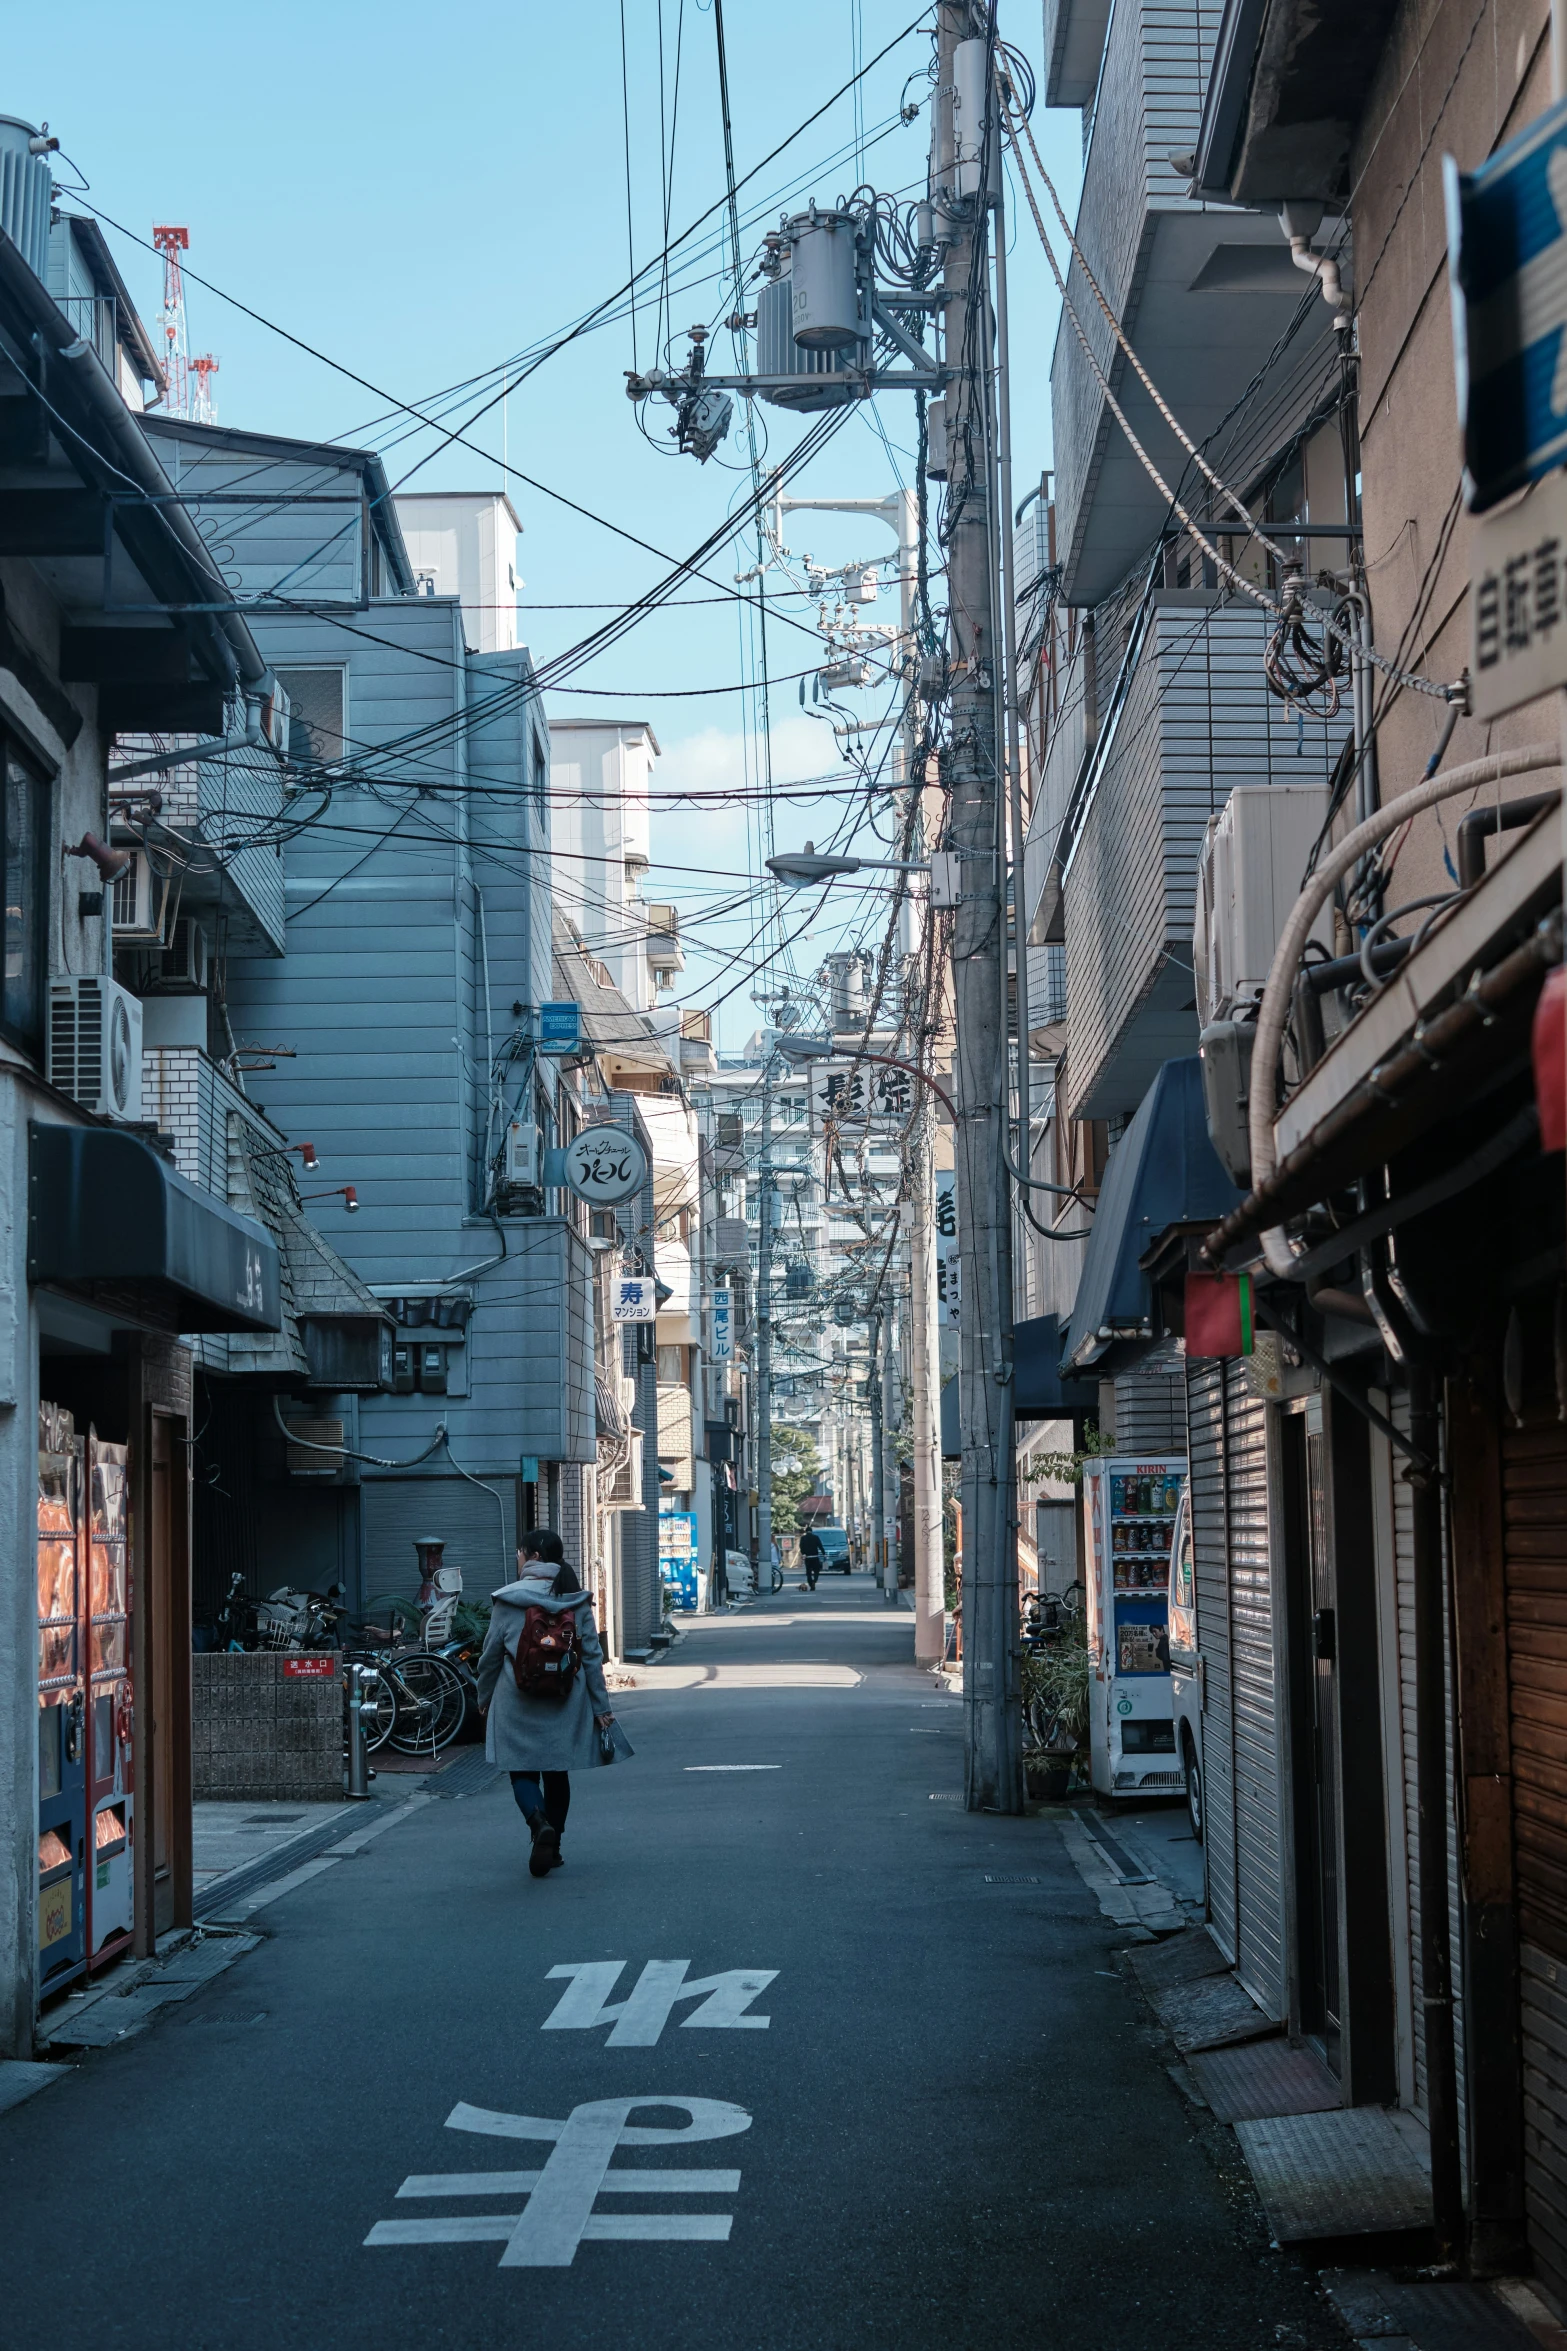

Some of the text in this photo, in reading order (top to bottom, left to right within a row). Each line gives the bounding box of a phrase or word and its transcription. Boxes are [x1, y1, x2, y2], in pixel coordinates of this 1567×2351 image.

[542, 1015, 577, 1023] AMERICAN
[549, 1022, 578, 1030] EXPRESS
[579, 1155, 632, 1185] パール
[620, 1281, 644, 1305] 寿
[949, 1272, 960, 1320] まつや
[614, 1307, 650, 1318] マンション
[714, 1291, 730, 1356] 西尾ビル
[1136, 1464, 1167, 1474] KIRIN
[290, 1659, 328, 1669] 送水口
